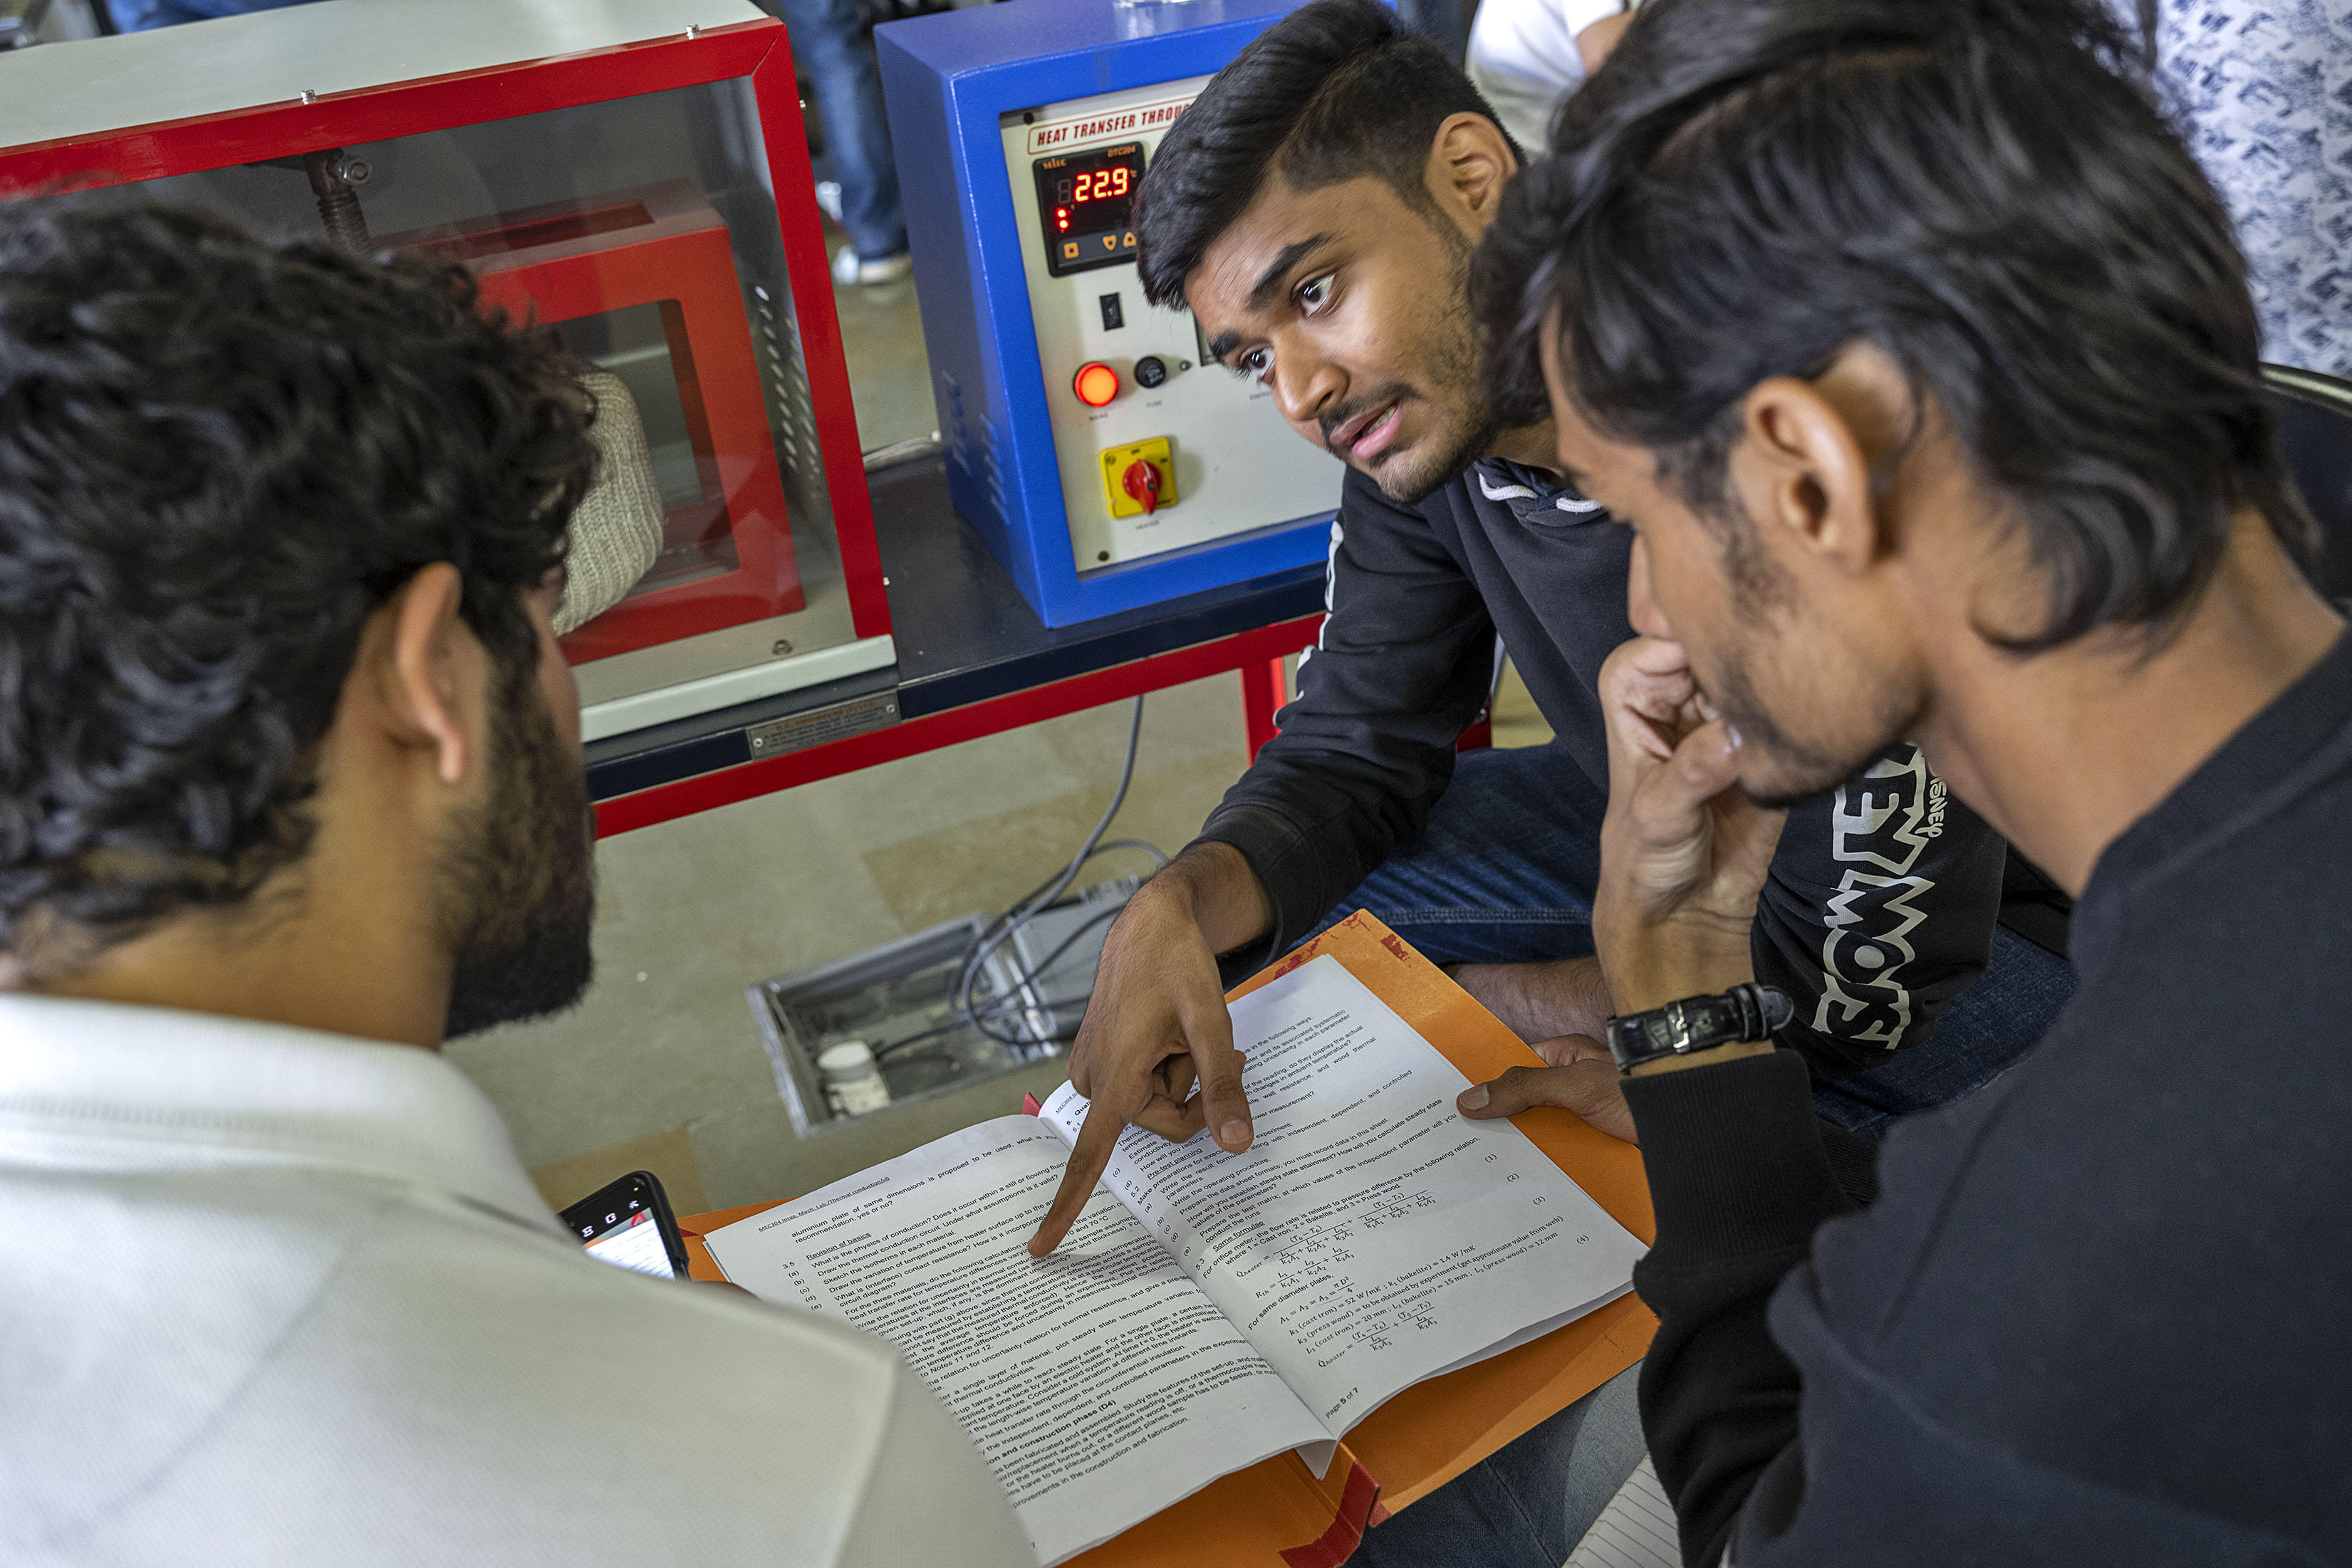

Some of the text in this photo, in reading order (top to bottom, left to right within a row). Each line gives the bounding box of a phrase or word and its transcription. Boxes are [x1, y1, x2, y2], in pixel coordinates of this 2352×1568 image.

[1037, 127, 1068, 146] HEAT
[1073, 114, 1137, 139] TRANSFER
[1074, 167, 1128, 203] 22.9
[1253, 1079, 1280, 1093] changes
[1287, 1062, 1312, 1077] ambient
[1312, 1039, 1351, 1064] temperature?
[1179, 1197, 1207, 1215] Prepare
[1220, 1184, 1235, 1193] data
[1236, 1174, 1255, 1186] sheet
[1282, 1159, 1296, 1167] you
[1296, 1152, 1313, 1161] must
[1313, 1144, 1336, 1155] record
[1334, 1138, 1350, 1148] data
[1356, 1129, 1369, 1138] this
[1485, 1154, 1497, 1163] (1)
[1507, 1173, 1519, 1182] (2)
[792, 1221, 828, 1237] aluminium
[831, 1212, 849, 1222] plate
[863, 1198, 883, 1208] same
[886, 1181, 925, 1199] dimensions
[938, 1160, 969, 1179] proposed
[1172, 1195, 1191, 1207] Write
[1203, 1173, 1236, 1189] operating
[1533, 1196, 1545, 1205] (3)
[795, 1218, 856, 1243] recommendation,
[857, 1211, 870, 1220] yes
[880, 1200, 892, 1209] no?
[811, 1258, 832, 1268] What
[854, 1240, 881, 1253] physics
[890, 1217, 931, 1238] conduction?
[932, 1210, 952, 1220] Does
[958, 1199, 977, 1210] occur
[978, 1190, 998, 1201] within
[1005, 1180, 1017, 1189] still
[1025, 1168, 1050, 1180] flowing
[1050, 1161, 1067, 1170] fluid?
[817, 1266, 837, 1276] Draw
[851, 1249, 879, 1263] thermal
[880, 1235, 919, 1252] conduction
[919, 1225, 942, 1237] circuit.
[942, 1216, 964, 1227] Under
[965, 1208, 983, 1218] what
[983, 1189, 1025, 1210] assumptions
[1039, 1174, 1058, 1185] valid?
[1203, 1266, 1212, 1279] For
[1213, 1250, 1233, 1266] orifice
[1269, 1223, 1284, 1232] flow
[1285, 1217, 1299, 1225] rate
[1308, 1203, 1332, 1215] related
[1340, 1189, 1371, 1204] pressure
[1371, 1176, 1403, 1191] difference
[1425, 1151, 1454, 1167] following
[1225, 1250, 1247, 1265] where
[1259, 1234, 1277, 1244] Cast
[1336, 1204, 1349, 1212] and
[1361, 1192, 1381, 1202] Press
[806, 1245, 838, 1260] Revision
[846, 1233, 871, 1245] basics
[823, 1272, 850, 1284] Sketch
[862, 1254, 898, 1269] isotherms
[908, 1243, 925, 1252] each
[926, 1230, 956, 1245] material.
[1195, 1221, 1265, 1270] 5.3 Some formulae
[1576, 1235, 1589, 1244] (4)
[839, 1281, 896, 1307] circuit diagram?
[1248, 1317, 1259, 1330] For
[1259, 1302, 1277, 1318] same
[1278, 1284, 1308, 1302] diameter
[930, 1361, 953, 1373] Notes
[966, 1349, 980, 1358] and
[953, 1366, 1036, 1403] thermal conductivities.
[1002, 1400, 1116, 1457] and construction phase (D4)
[1326, 1403, 1341, 1419] Page
